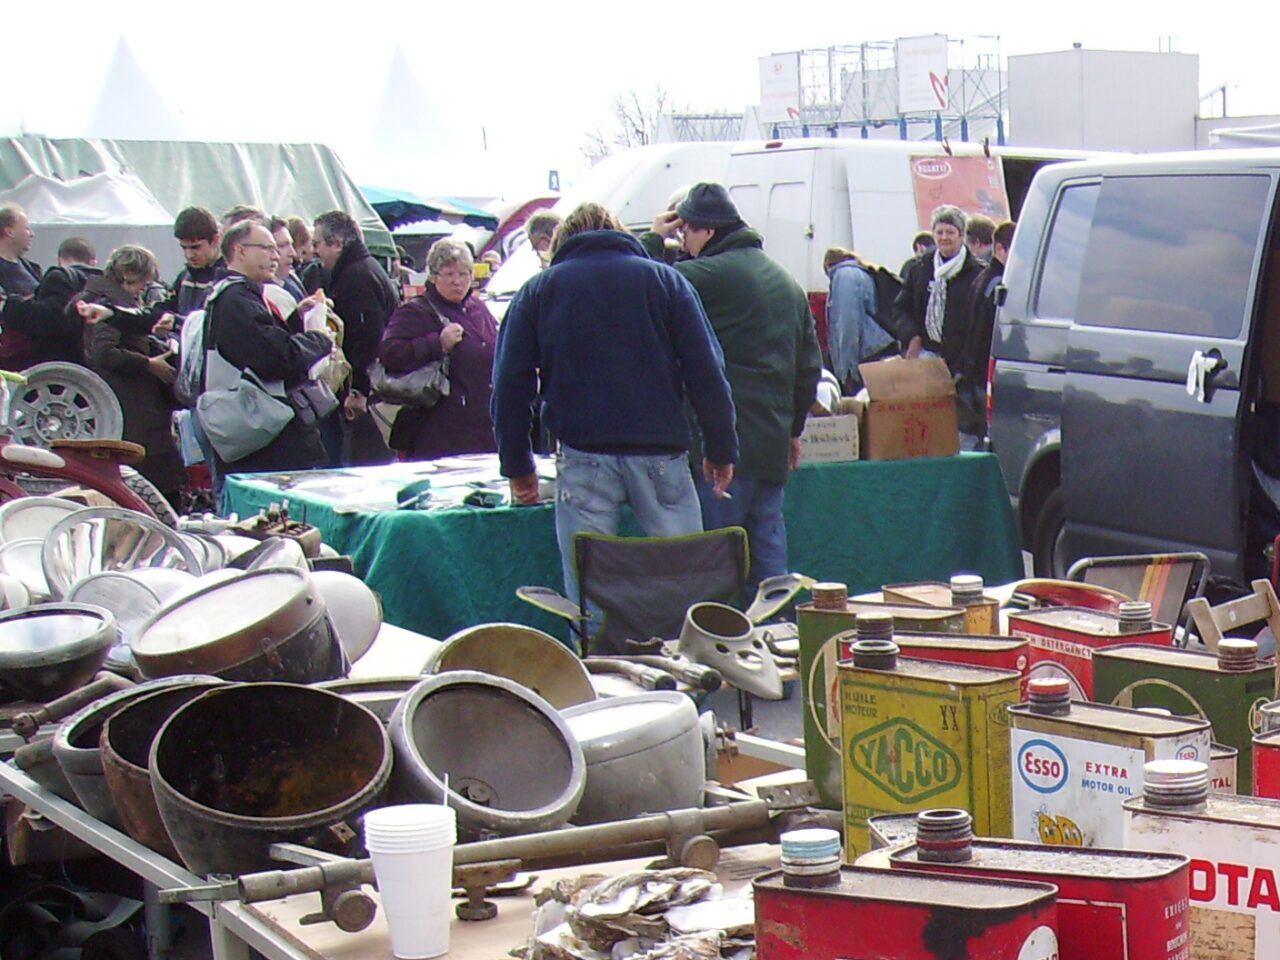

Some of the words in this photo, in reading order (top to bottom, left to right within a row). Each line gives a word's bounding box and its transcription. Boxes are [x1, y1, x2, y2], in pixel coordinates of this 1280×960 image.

[859, 727, 948, 793] YACCO
[1025, 751, 1061, 778] ESSO
[1085, 761, 1128, 779] EXTRA
[1082, 778, 1114, 793] MOTOR
[1117, 785, 1133, 796] OIL
